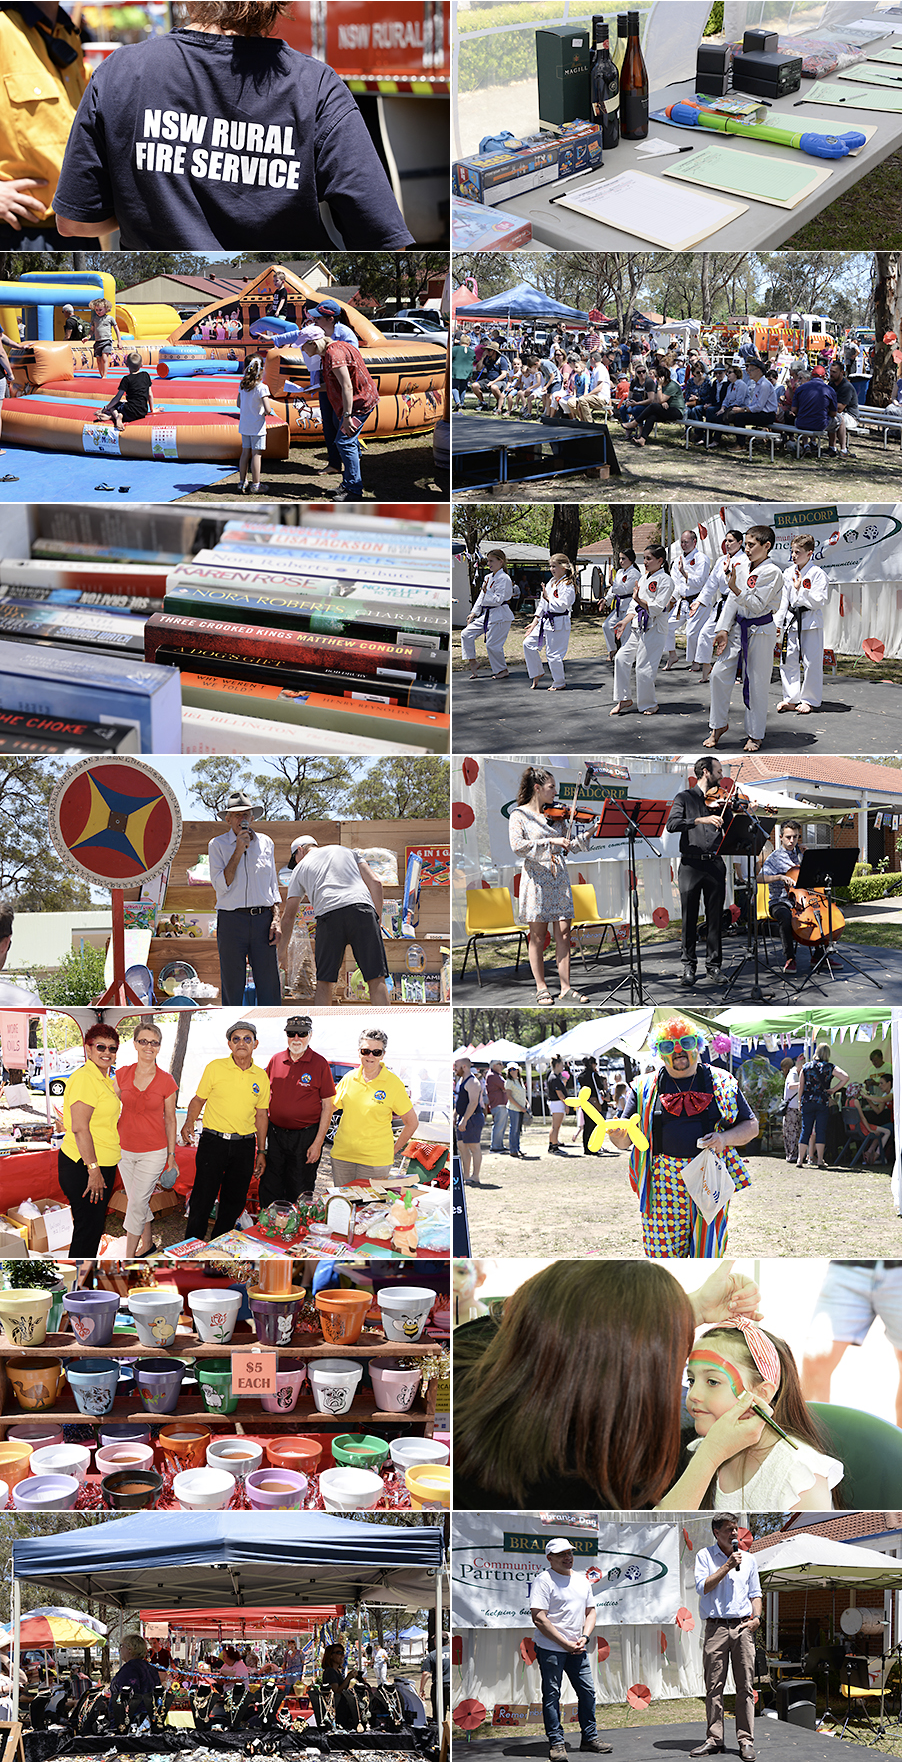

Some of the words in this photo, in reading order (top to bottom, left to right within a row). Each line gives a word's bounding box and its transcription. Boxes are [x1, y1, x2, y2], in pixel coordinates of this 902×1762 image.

[338, 23, 371, 50] NSW
[564, 66, 588, 75] MAGILL
[143, 109, 208, 145] NSW
[211, 117, 296, 156] RURAL
[135, 142, 187, 175] FIRE
[190, 149, 301, 190] SERVICE
[777, 509, 834, 525] BRADCORP
[276, 535, 310, 545] LISA
[313, 538, 384, 552] JACKSON
[212, 553, 254, 564] Nora
[260, 559, 330, 571] Roberts
[355, 569, 414, 580] Tribute
[174, 566, 250, 582] KAREN
[251, 574, 321, 589] ROSE
[192, 589, 250, 603] NORA
[256, 595, 346, 614] ROBERTS
[355, 609, 448, 625] CHARMED
[159, 616, 197, 627] THREE
[198, 621, 254, 634] CROOKED
[255, 629, 293, 640] KINGS
[296, 634, 357, 648] MATTHEW
[359, 642, 414, 656] CONDON
[190, 648, 241, 661] DOG'S
[242, 656, 286, 667] GIFT
[322, 697, 354, 706] HENRY
[358, 703, 411, 715] REYNOLDS
[26, 717, 88, 735] CHOKE
[210, 716, 297, 736] BILLINGTON
[563, 786, 625, 800] BRADCORP
[246, 1362, 263, 1373] $5
[238, 1378, 271, 1389] EACH
[473, 1557, 544, 1573] Community
